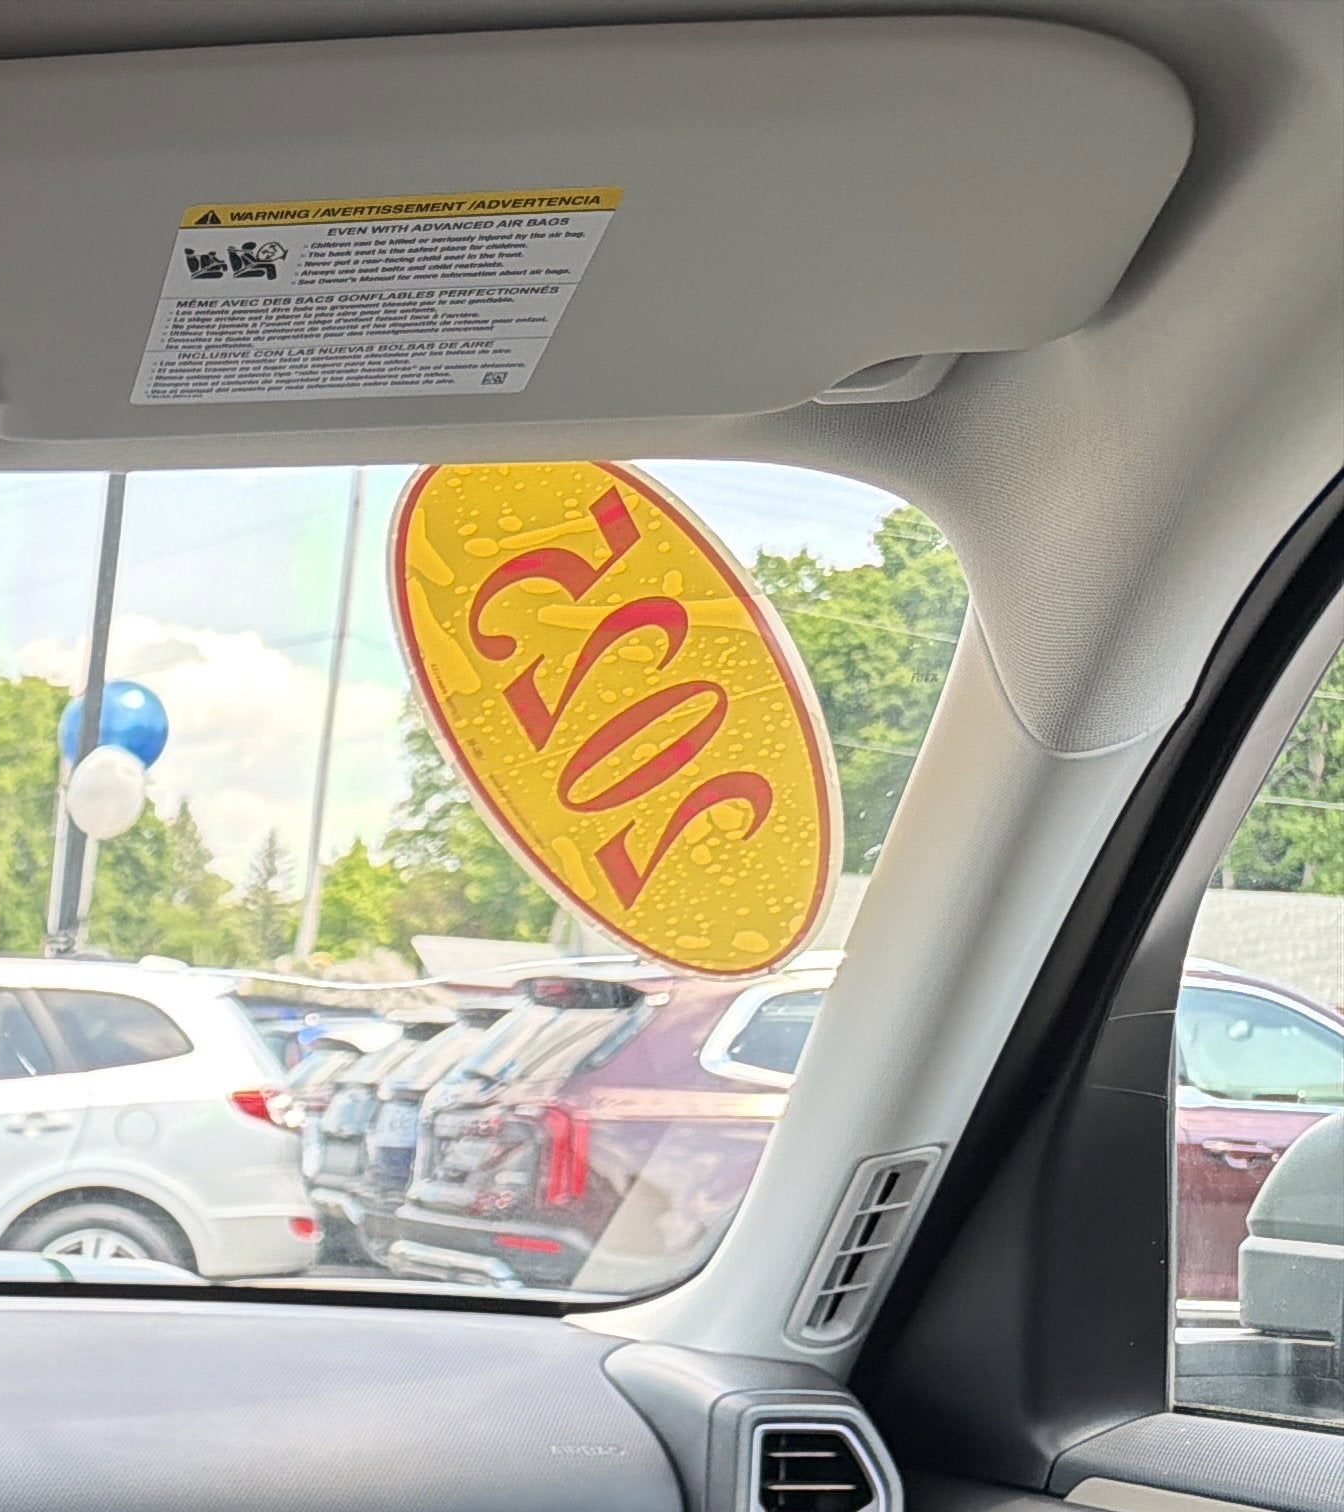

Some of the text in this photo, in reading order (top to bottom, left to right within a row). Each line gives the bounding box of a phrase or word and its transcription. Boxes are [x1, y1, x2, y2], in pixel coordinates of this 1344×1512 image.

[229, 209, 310, 221] WARNING
[327, 217, 570, 237] EVEN WITH ADVANCED AIR BAGS
[220, 299, 258, 307] AVEC
[262, 298, 291, 307] DES
[294, 296, 332, 304] SACS
[338, 291, 434, 302] GONFLABLES
[177, 340, 495, 360] INCLUSIVE CON LAS NUEVAS BOLSAS DE AIRE
